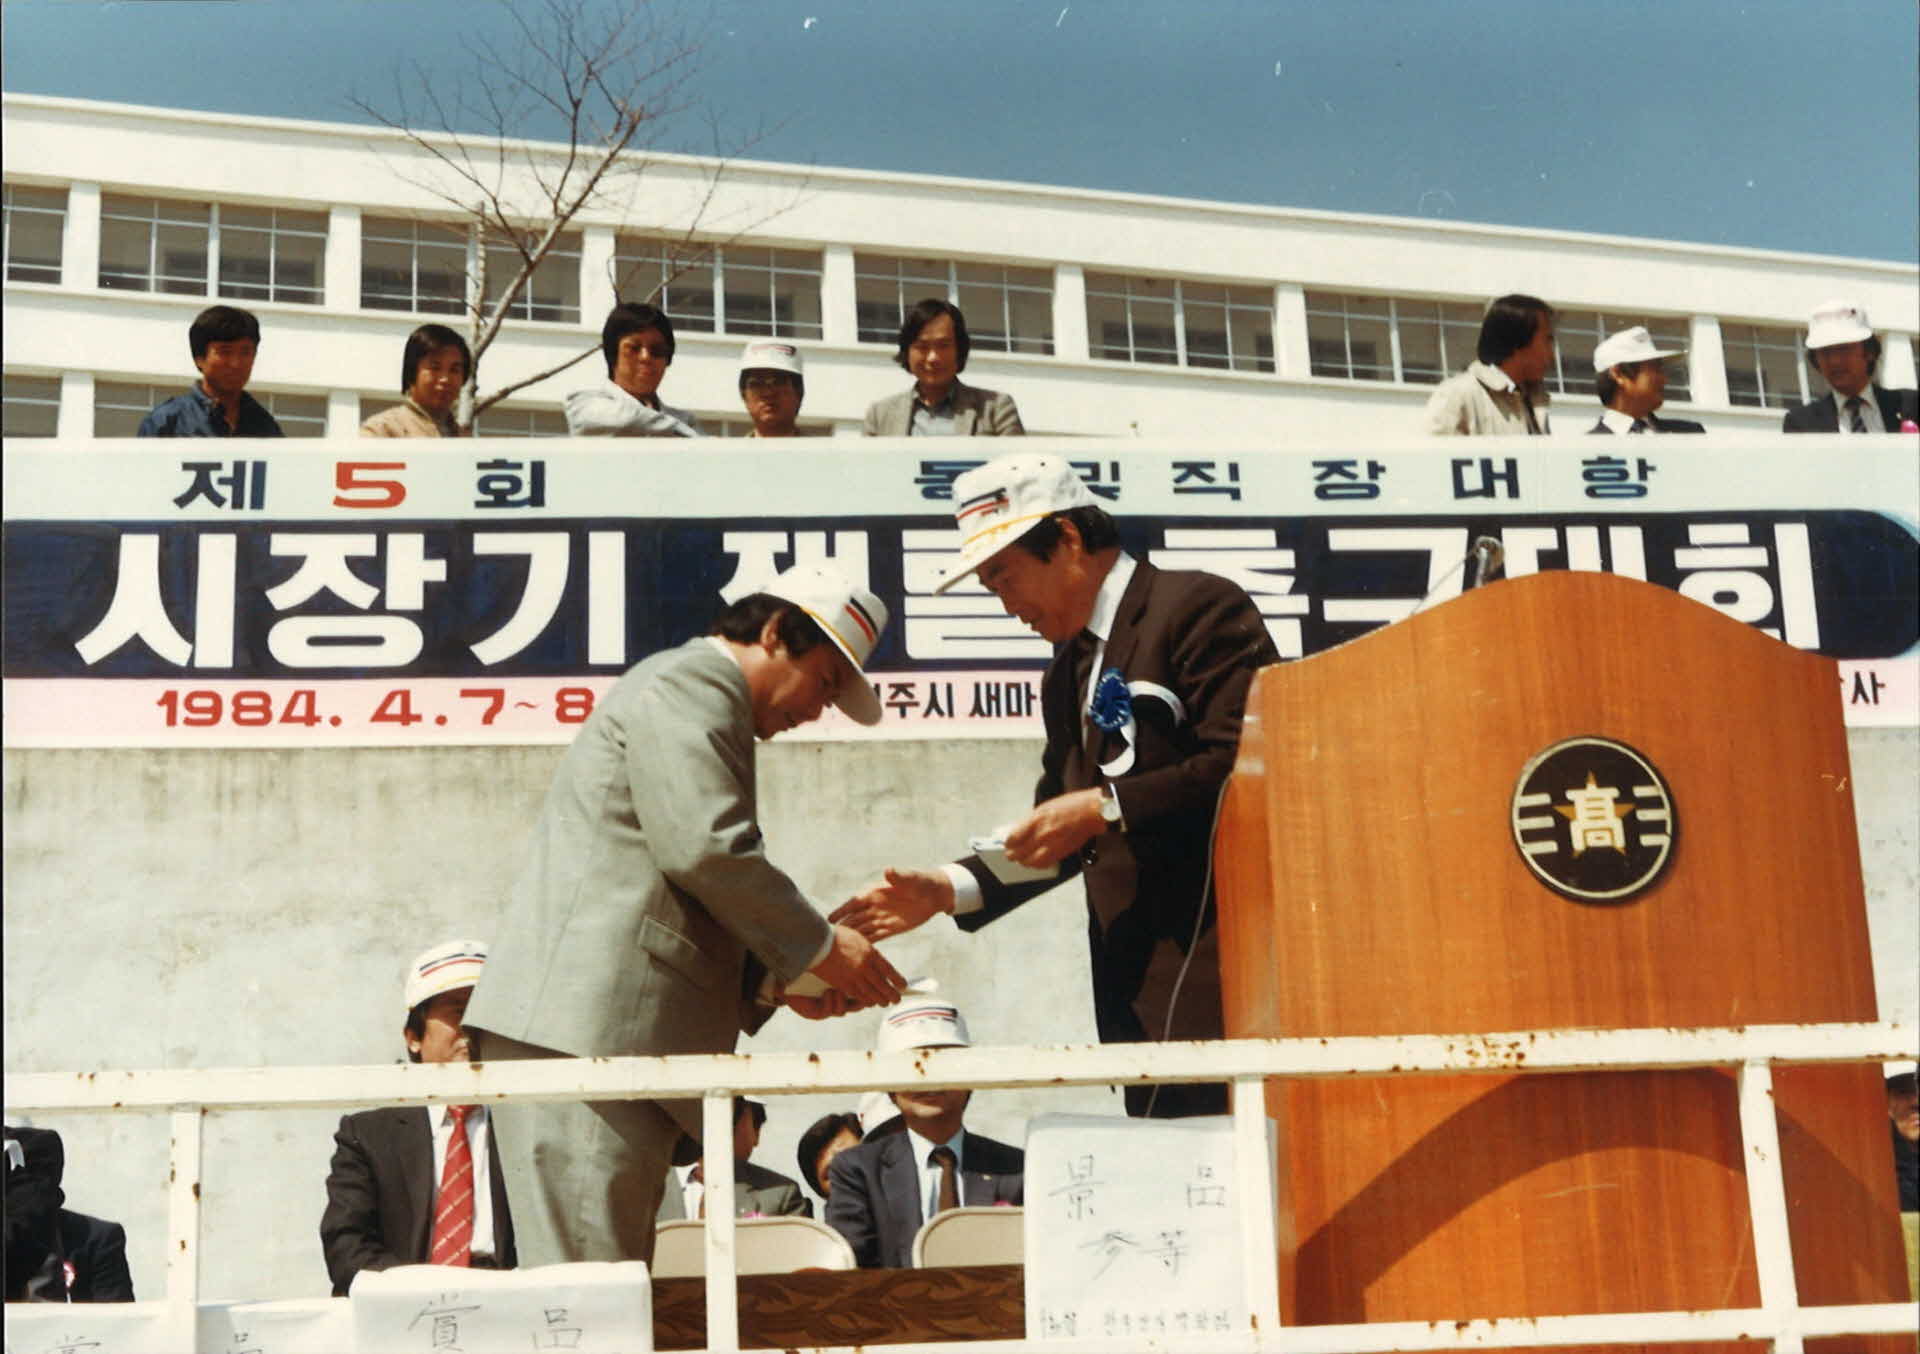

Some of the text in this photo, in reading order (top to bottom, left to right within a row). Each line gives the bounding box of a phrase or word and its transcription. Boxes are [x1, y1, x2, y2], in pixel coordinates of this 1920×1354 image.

[74, 531, 626, 668] 시장기
[873, 682, 955, 719] 주시
[1840, 671, 1886, 705] 사
